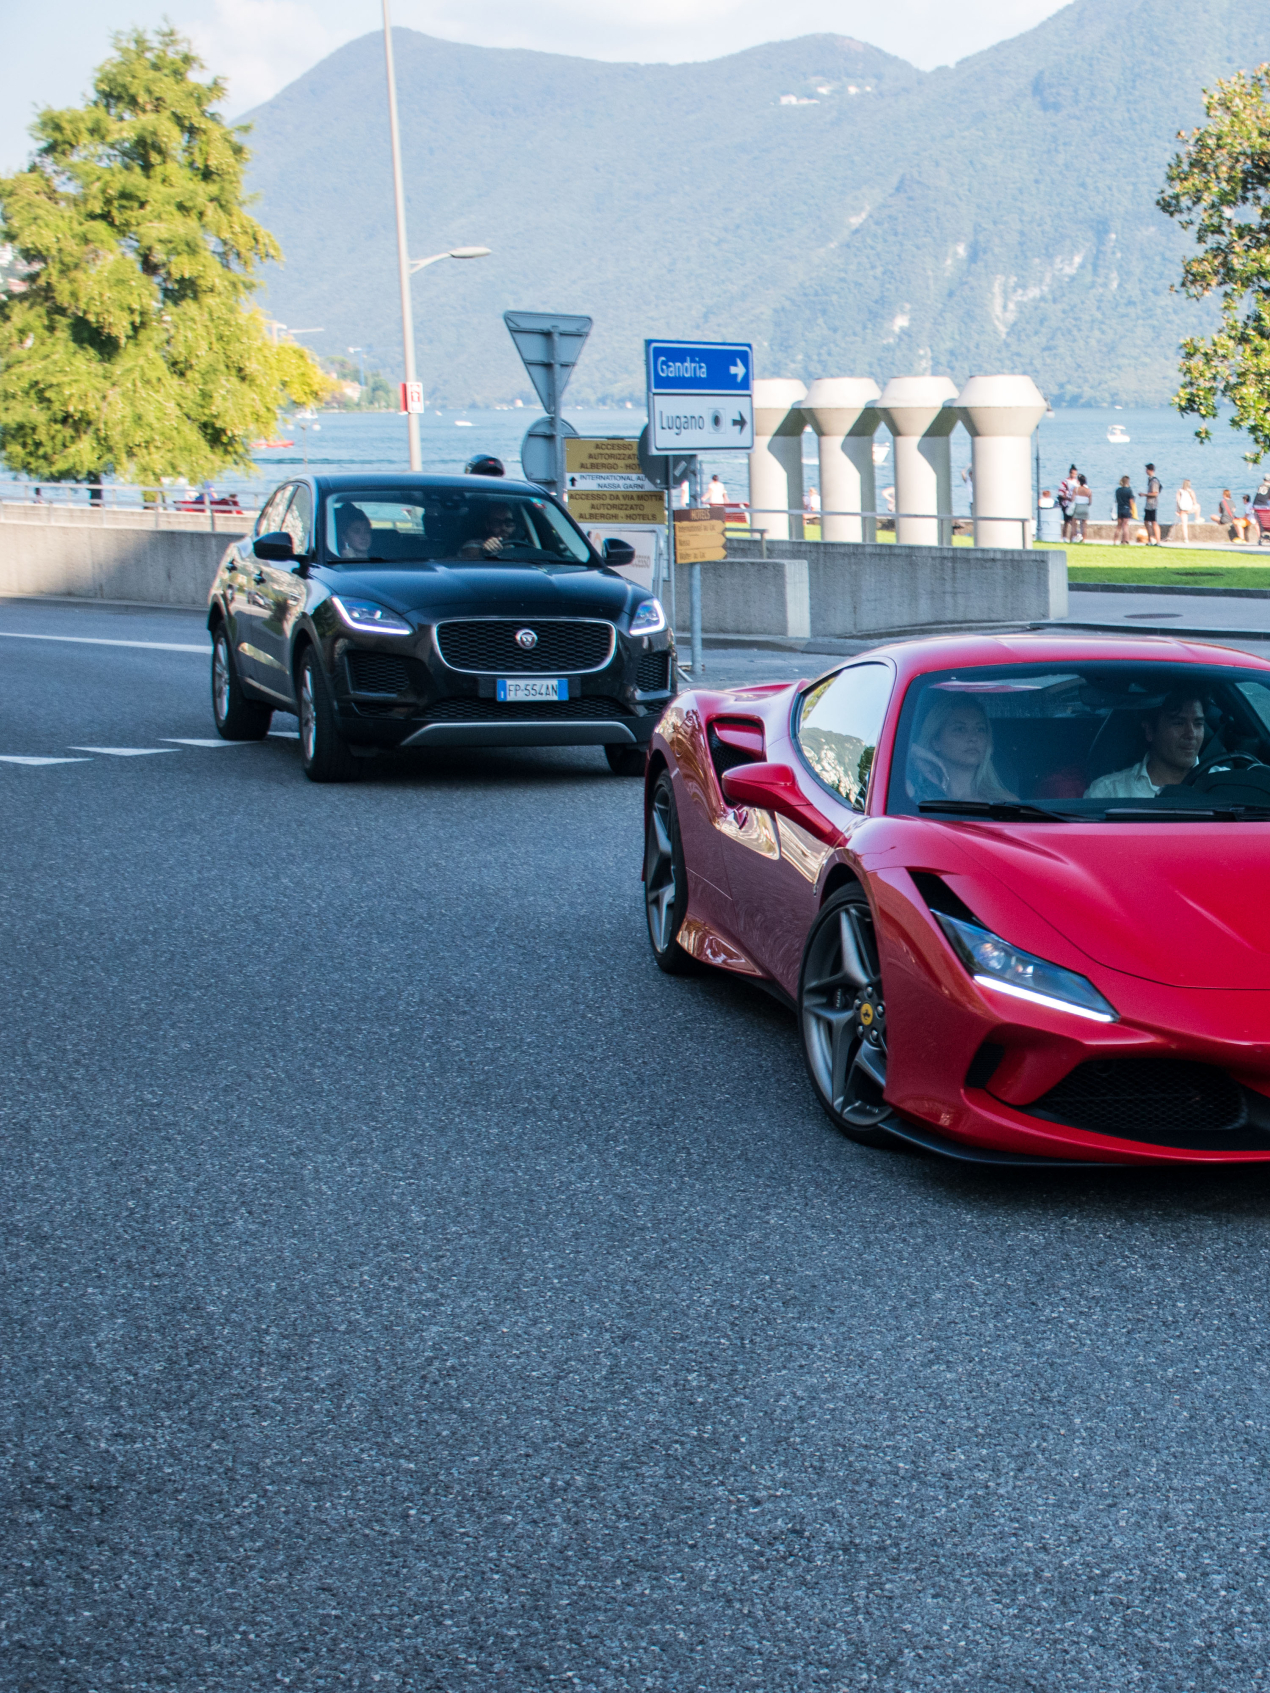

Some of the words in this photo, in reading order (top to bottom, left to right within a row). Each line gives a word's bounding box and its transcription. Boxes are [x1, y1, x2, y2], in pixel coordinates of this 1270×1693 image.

[657, 356, 707, 378] Gandria
[659, 410, 705, 436] Lugano
[595, 443, 633, 451] ACCESSO
[580, 462, 618, 470] ALBERGO
[569, 493, 607, 501] ACCESSO
[639, 494, 663, 502] MOTTA
[591, 503, 645, 511] AUTORIZZATO
[626, 513, 657, 521] HOTELS
[691, 509, 710, 520] HOTELS
